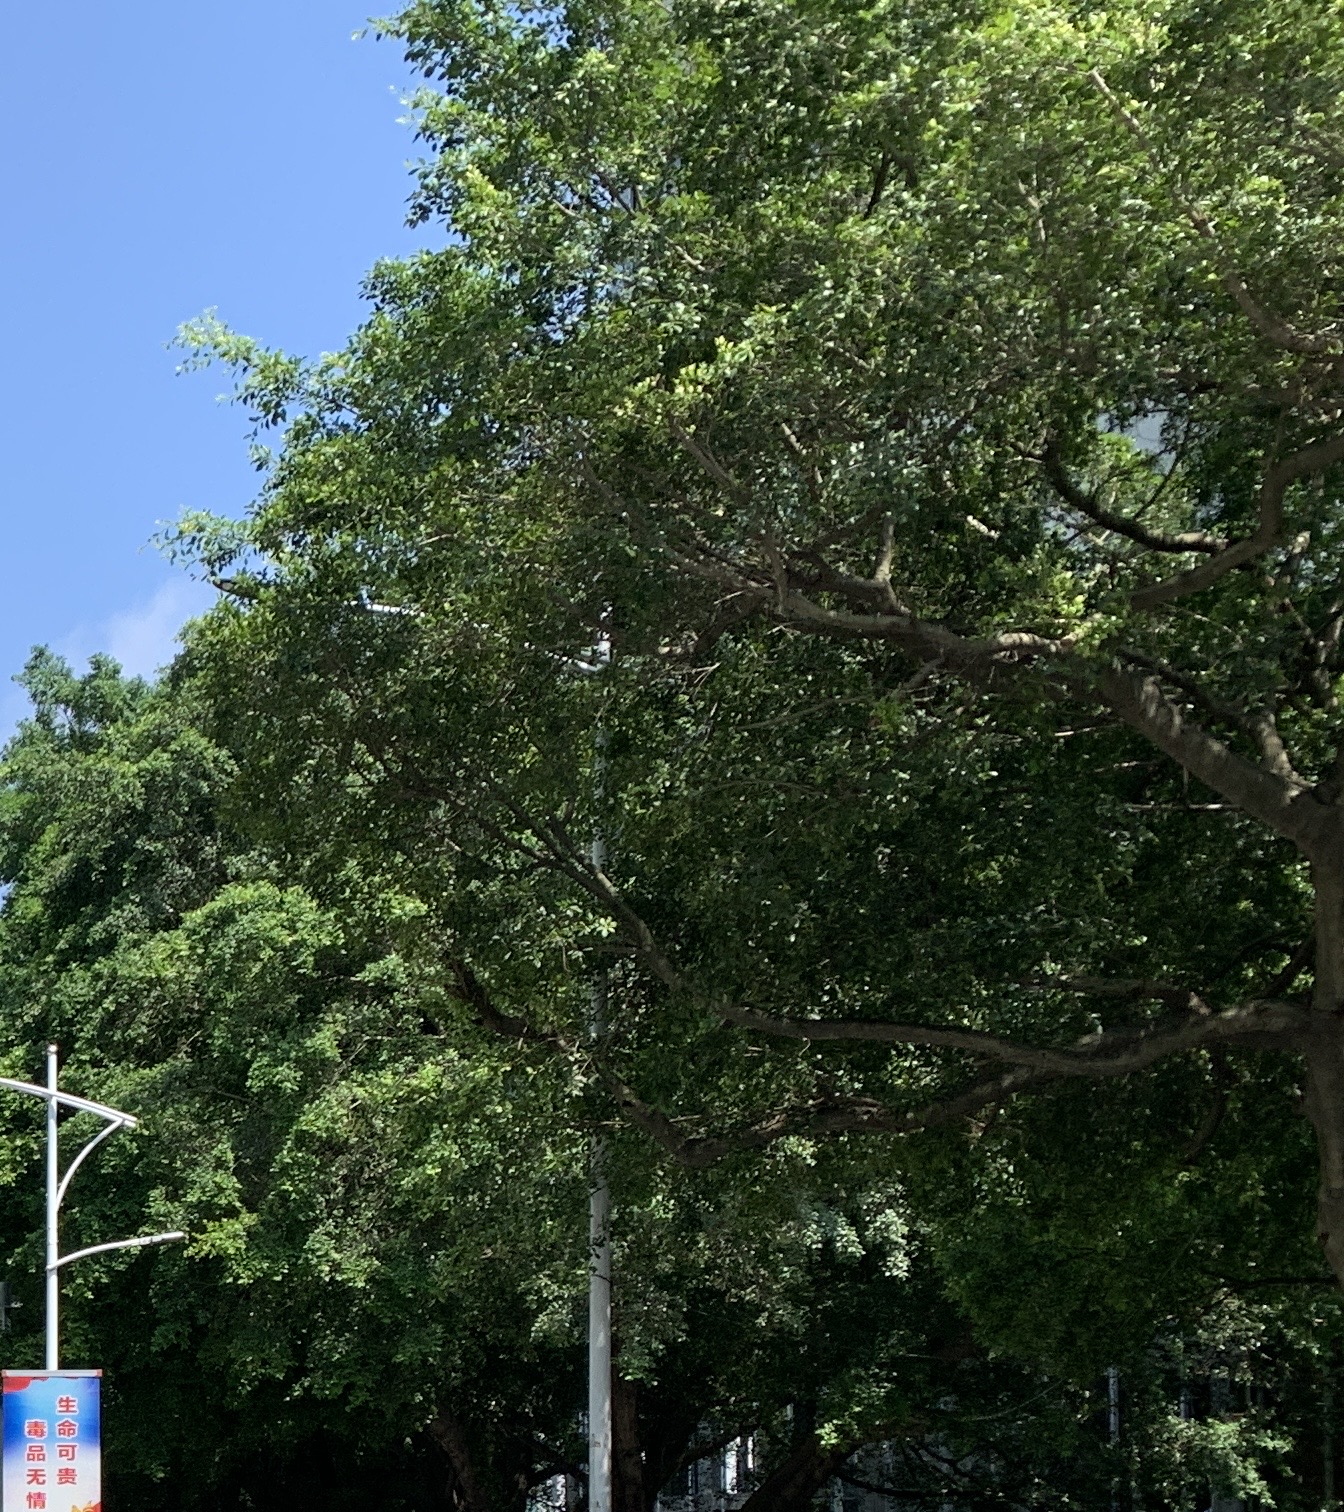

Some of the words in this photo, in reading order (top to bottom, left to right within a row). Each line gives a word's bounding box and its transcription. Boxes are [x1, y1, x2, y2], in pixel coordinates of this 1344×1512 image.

[26, 1420, 47, 1510] 毒品无情
[56, 1395, 78, 1486] 生命可贵
